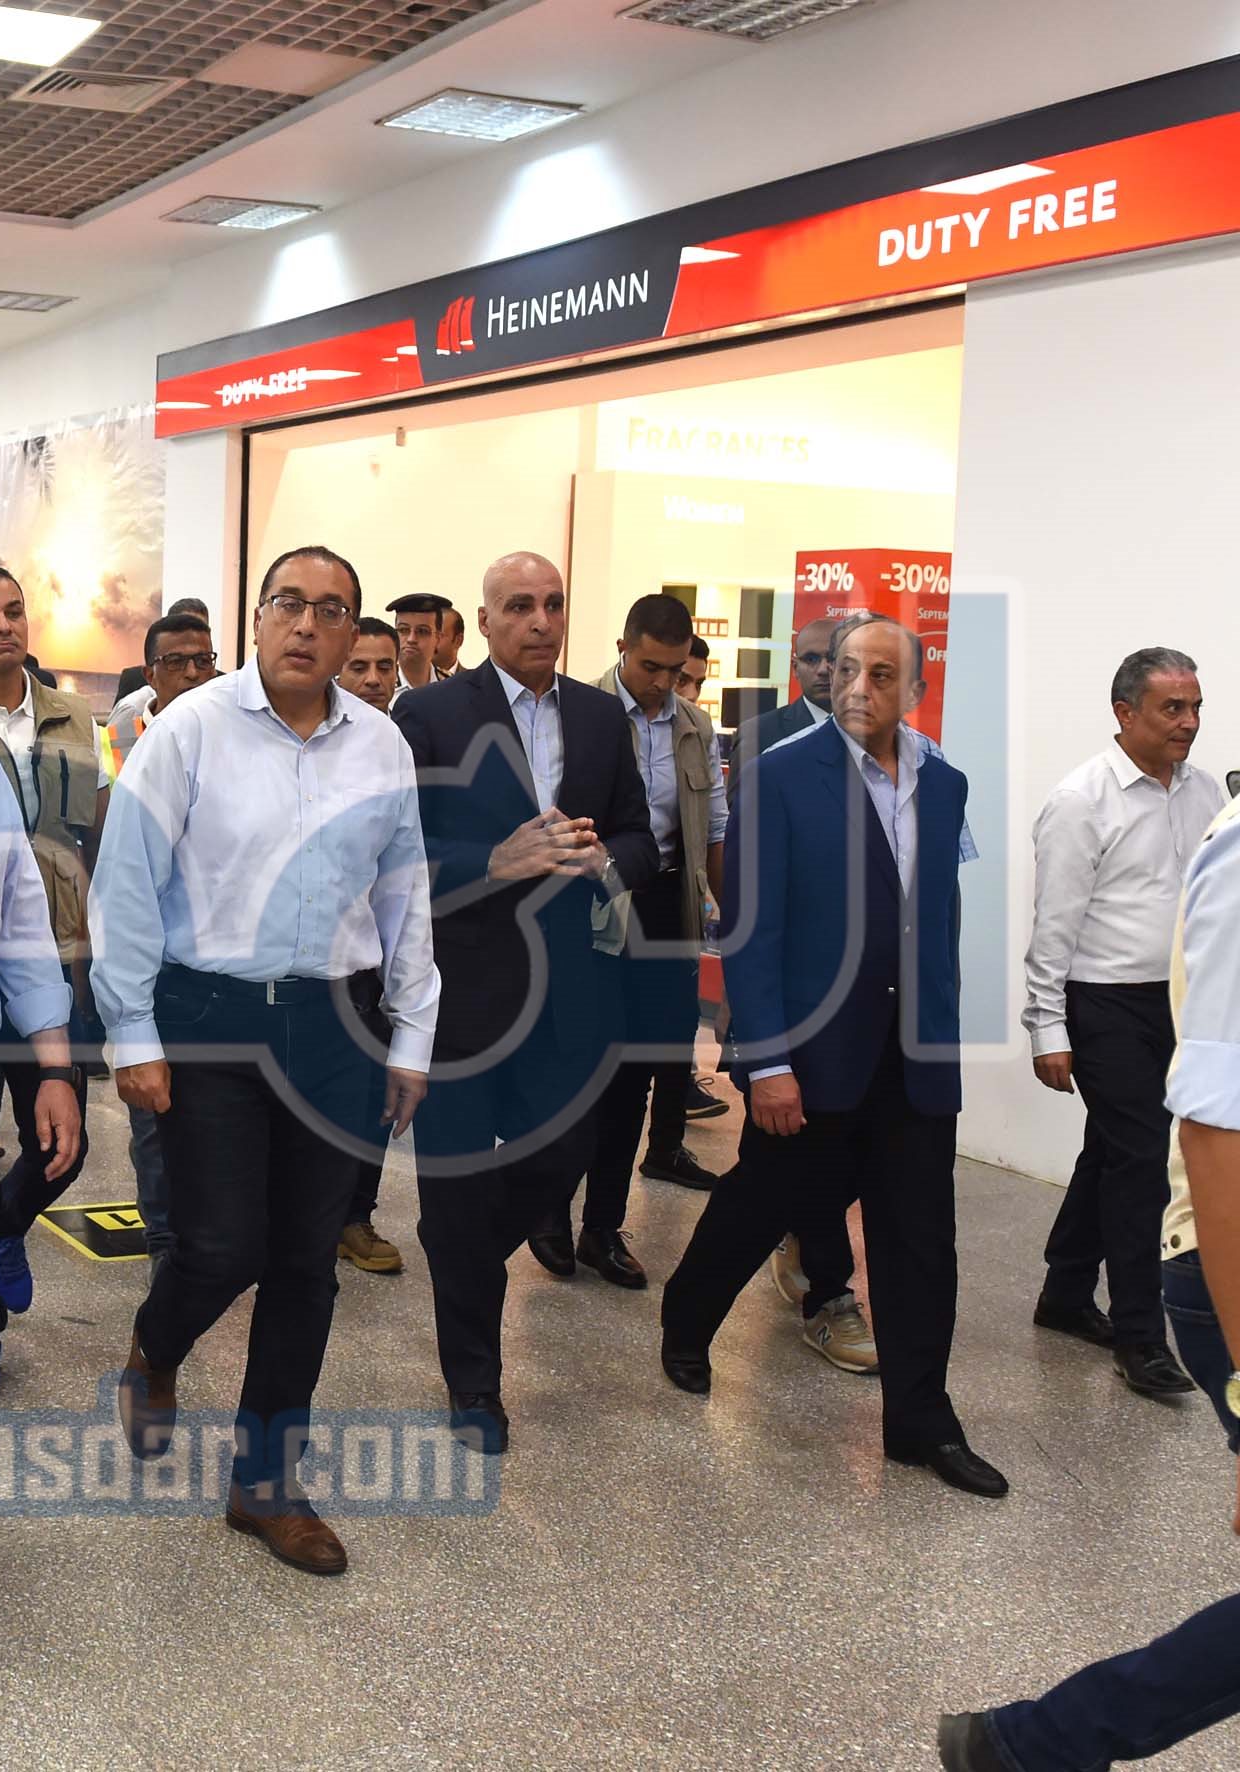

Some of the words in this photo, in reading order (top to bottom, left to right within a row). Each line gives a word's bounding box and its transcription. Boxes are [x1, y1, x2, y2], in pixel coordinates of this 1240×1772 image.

[877, 207, 991, 268] DUTY
[1008, 179, 1117, 240] FREE
[486, 269, 649, 339] HEINEMANN
[222, 376, 263, 407] DUTY
[269, 367, 308, 397] FREE
[796, 562, 855, 592] -30%
[880, 562, 950, 595] -30%
